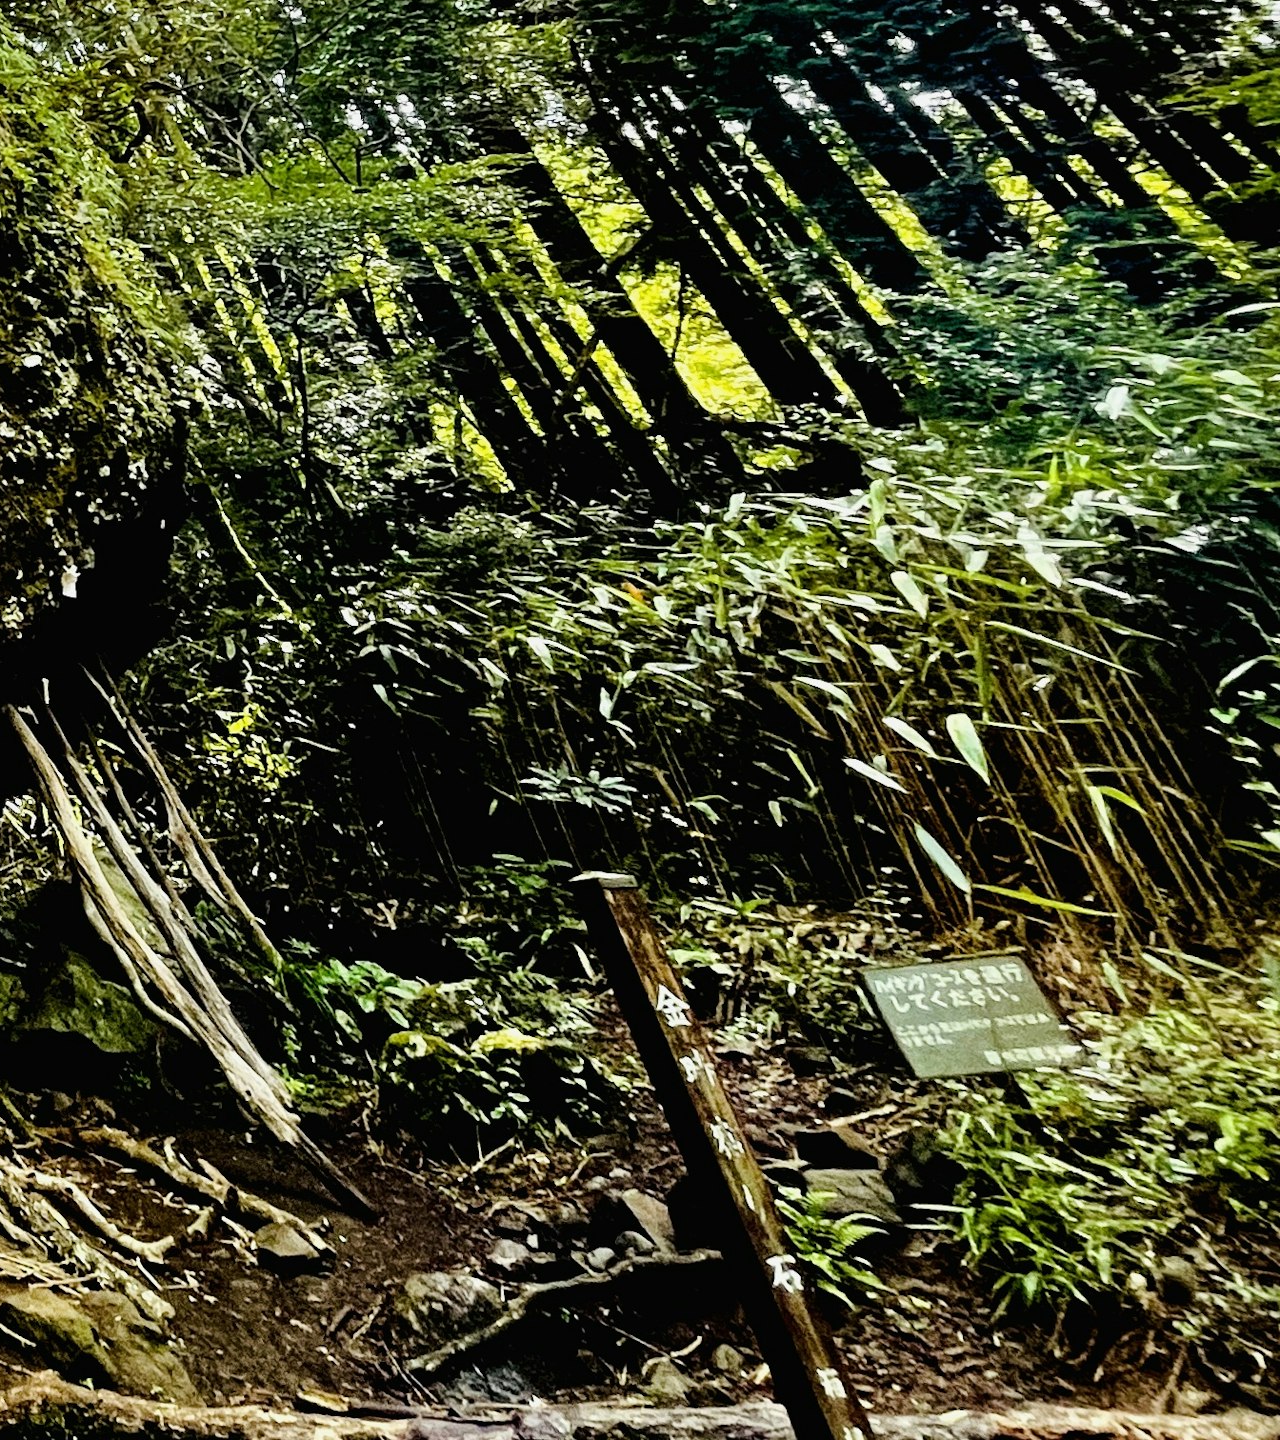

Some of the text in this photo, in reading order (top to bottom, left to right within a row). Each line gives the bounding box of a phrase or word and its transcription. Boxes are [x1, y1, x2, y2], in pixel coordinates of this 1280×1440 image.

[889, 986, 1020, 1013] してください。
